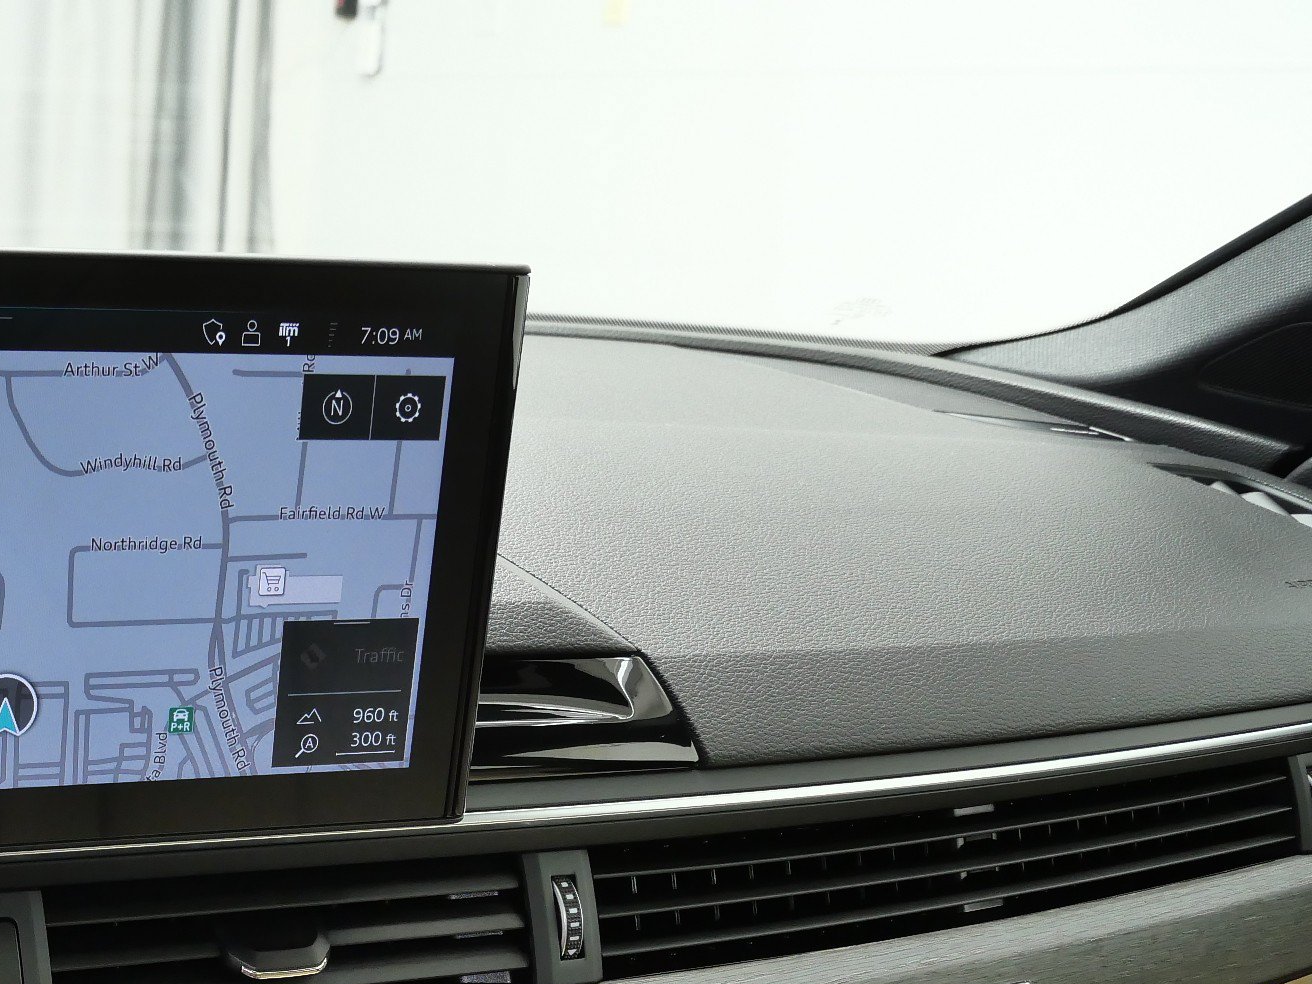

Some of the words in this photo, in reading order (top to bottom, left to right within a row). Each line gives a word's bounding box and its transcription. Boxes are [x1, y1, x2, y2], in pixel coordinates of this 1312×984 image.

[360, 327, 400, 345] 7:09
[403, 328, 423, 342] AM
[63, 362, 118, 377] Arthur
[123, 362, 141, 377] St
[141, 352, 159, 371] W
[188, 391, 227, 483] Plymouth
[218, 485, 234, 509] Rd
[79, 453, 158, 475] Windyhill
[162, 456, 183, 472] Rd
[278, 506, 341, 521] Fairfield
[346, 506, 365, 520] Rd
[369, 506, 386, 520] W
[90, 536, 178, 554] Northridge
[182, 536, 203, 551] Rd
[400, 579, 414, 598] Dr
[354, 647, 405, 664] Traffic
[208, 666, 240, 748] Plymouth
[231, 748, 251, 771] Rd
[353, 707, 385, 724] 960
[388, 710, 399, 722] ft
[170, 722, 191, 732] P+R
[153, 732, 168, 765] Blvd
[350, 732, 382, 747] 300
[386, 734, 397, 747] ft
